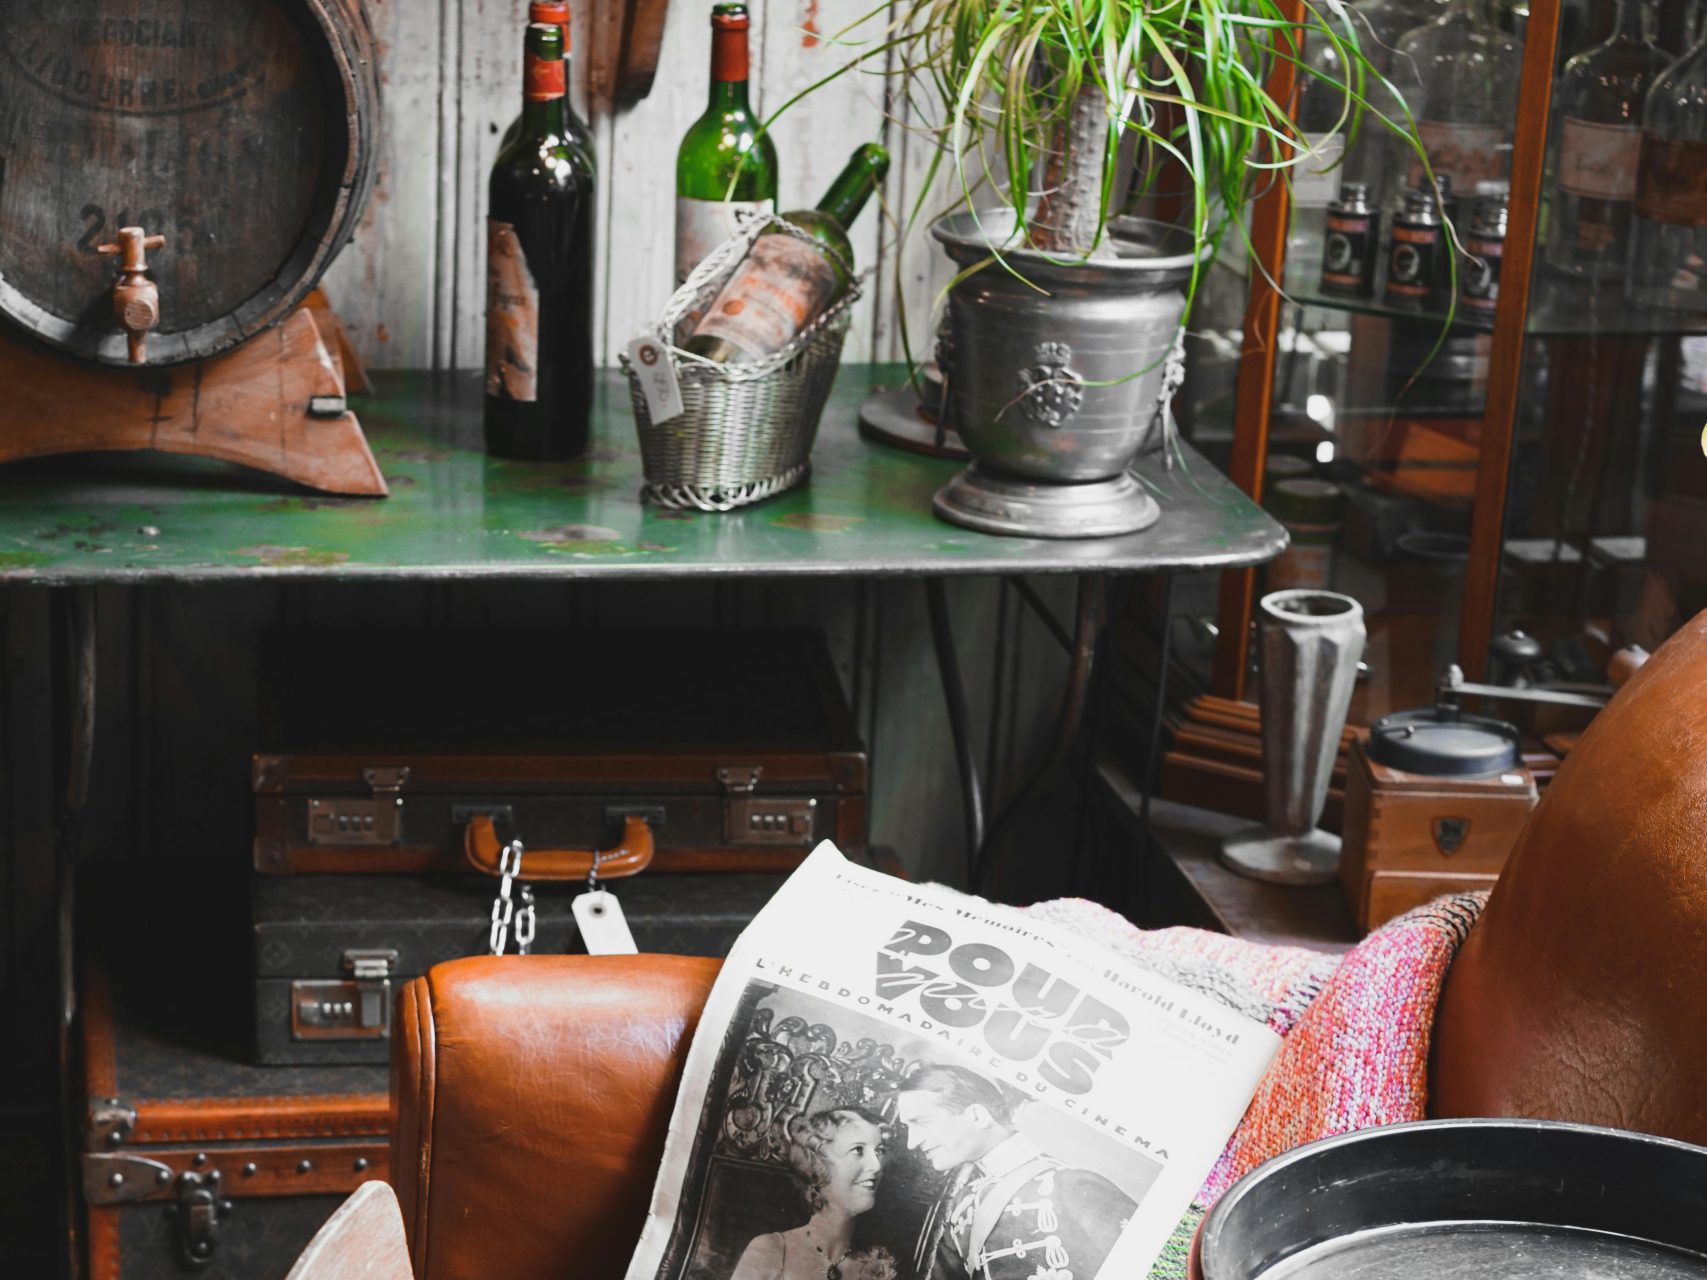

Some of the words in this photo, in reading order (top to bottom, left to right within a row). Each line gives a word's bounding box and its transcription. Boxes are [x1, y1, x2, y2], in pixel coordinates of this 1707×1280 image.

[875, 951, 1101, 1095] VOUS
[883, 919, 1131, 1061] POUR
[1103, 968, 1175, 1014] Harold
[1178, 1007, 1241, 1046] Lloyd
[1015, 1071, 1048, 1093] DU
[1064, 1098, 1169, 1160] CINEMA
